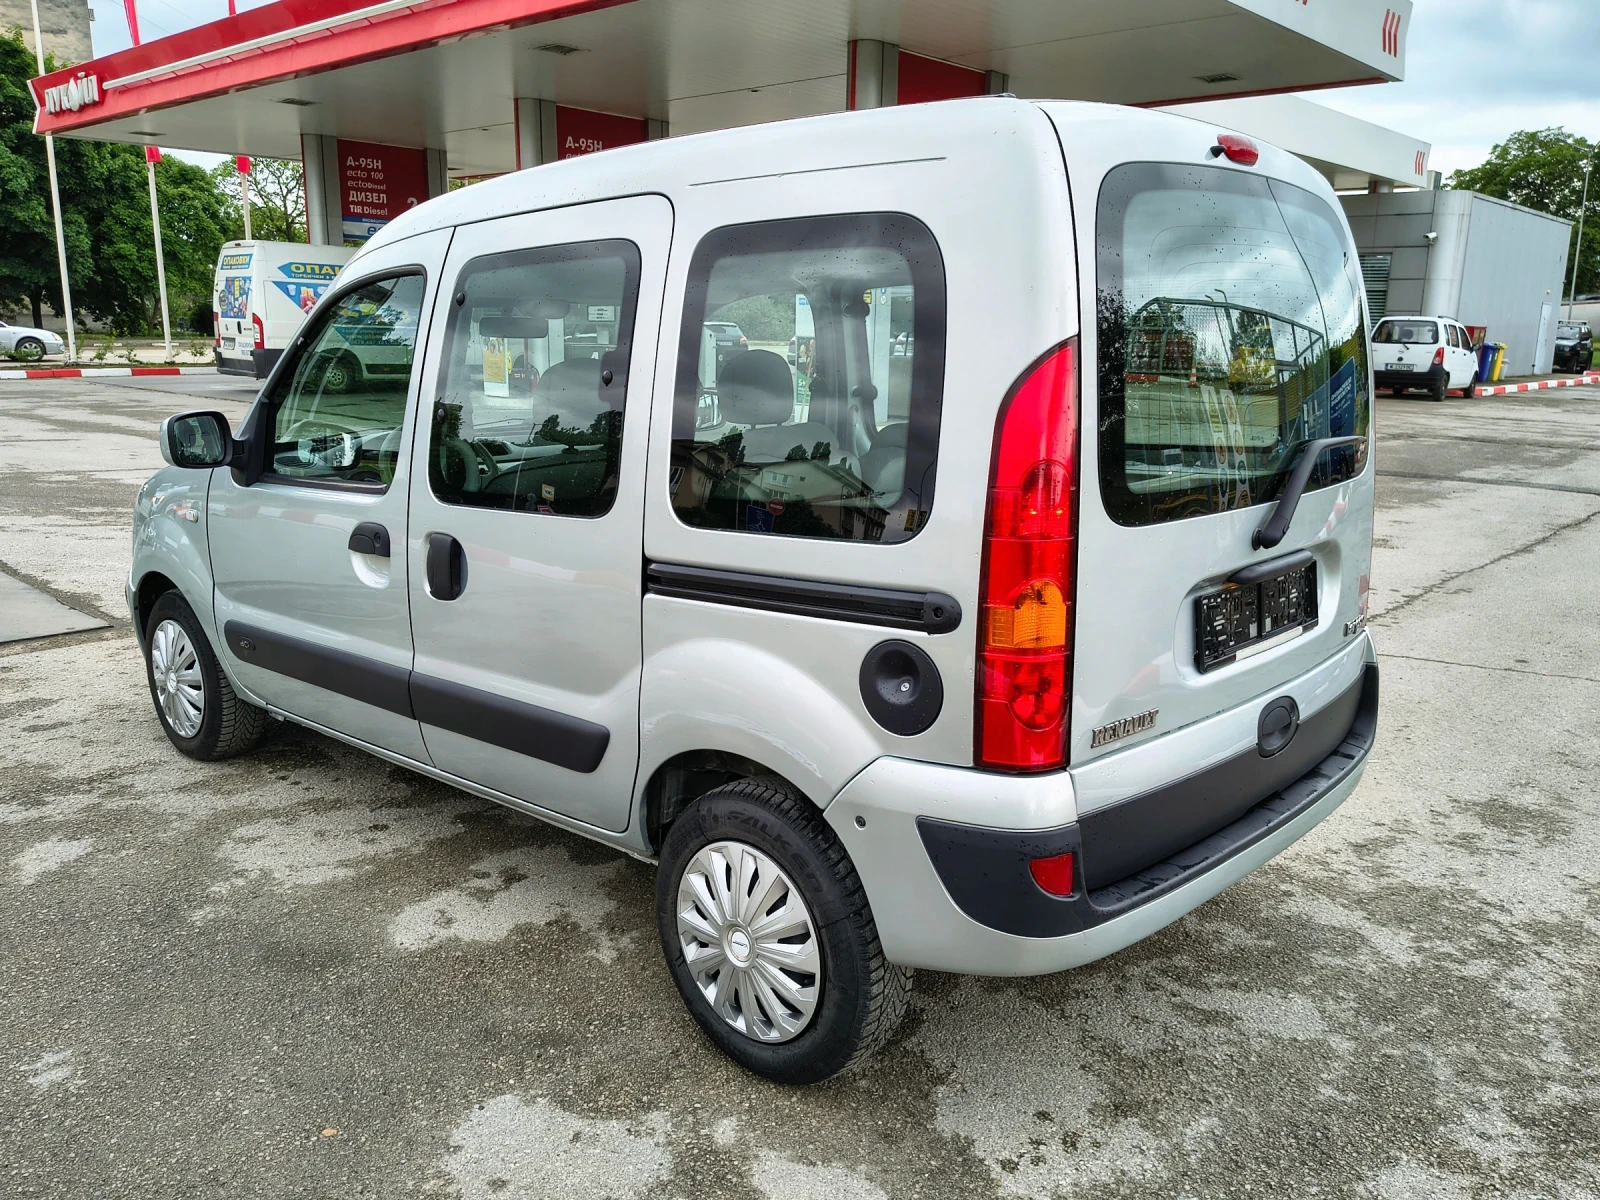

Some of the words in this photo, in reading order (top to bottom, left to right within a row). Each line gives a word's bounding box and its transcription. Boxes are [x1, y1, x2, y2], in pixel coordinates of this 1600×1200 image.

[346, 170, 368, 178] ecto
[370, 171, 384, 180] 100
[348, 190, 387, 204] ДИЗЕЛ
[349, 204, 363, 214] TIR
[363, 206, 388, 216] Diesel
[1091, 707, 1160, 749] RENAULT
